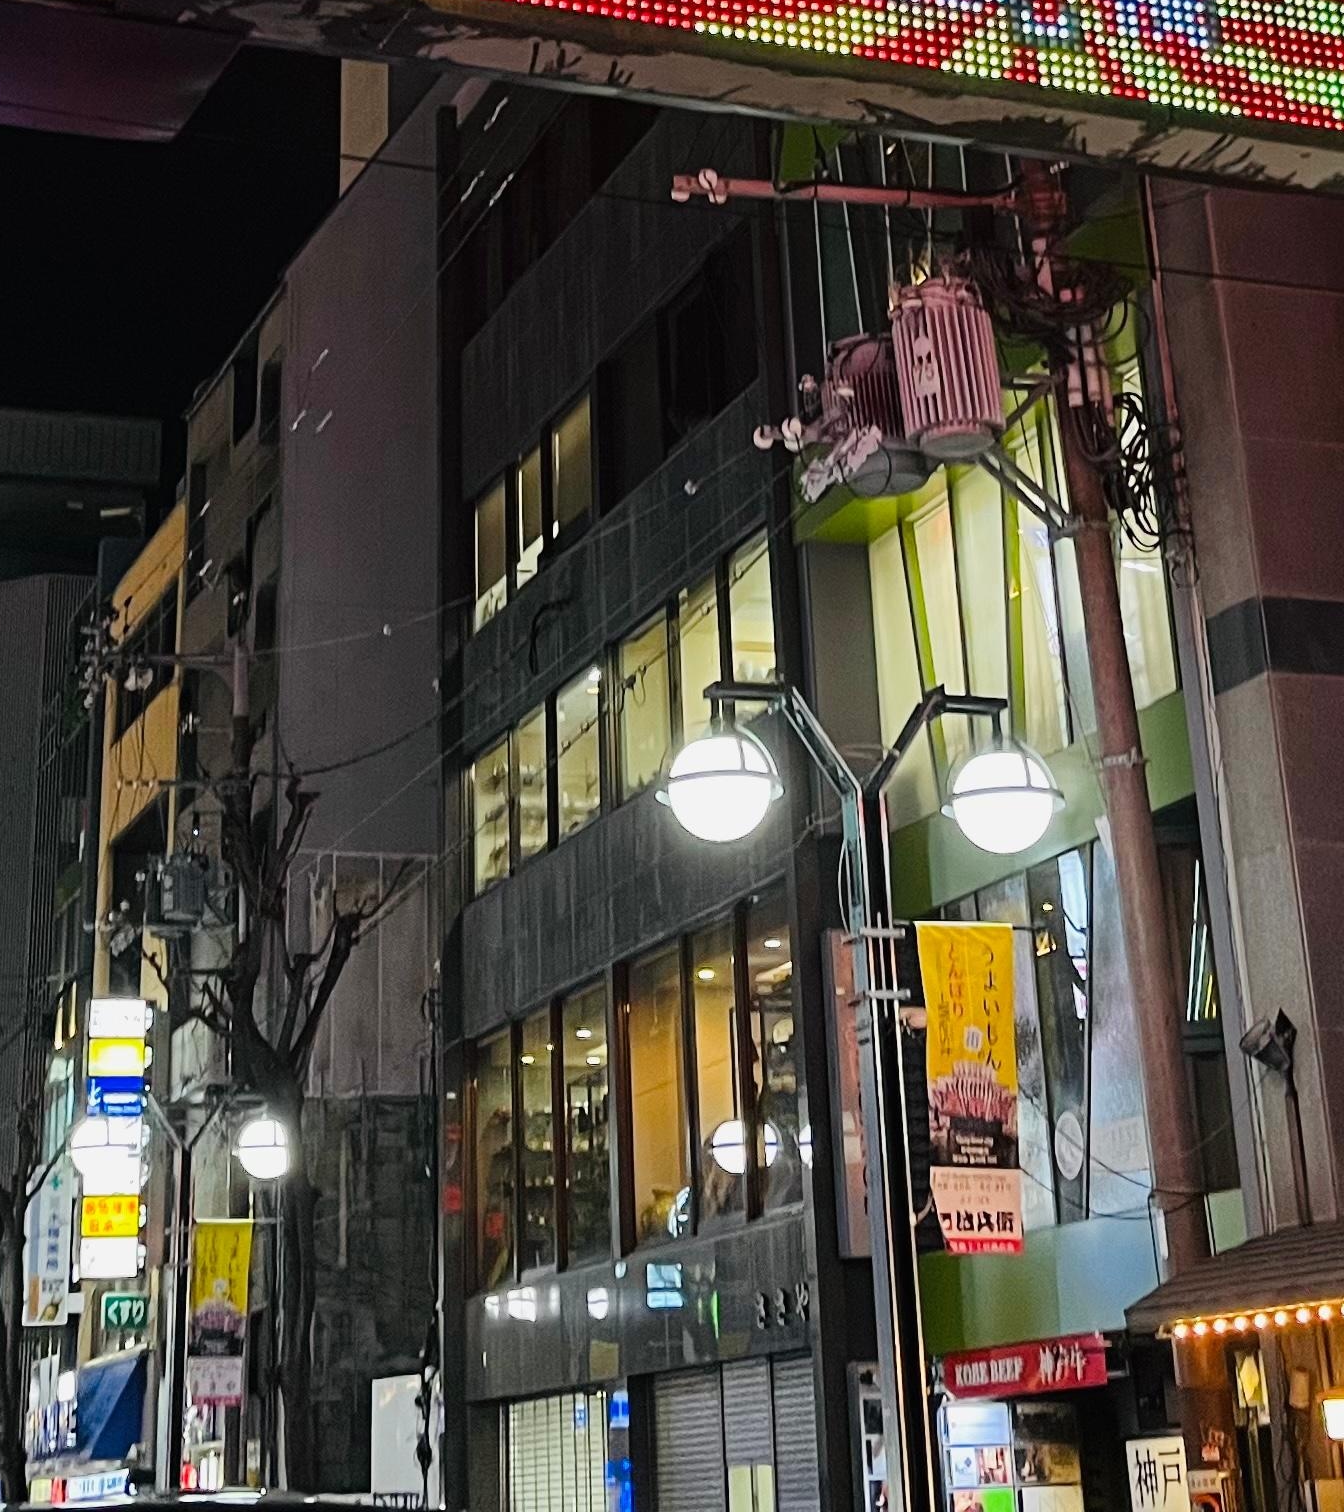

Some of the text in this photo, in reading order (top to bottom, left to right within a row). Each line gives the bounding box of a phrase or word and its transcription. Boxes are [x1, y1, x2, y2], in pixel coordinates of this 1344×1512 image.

[106, 1298, 146, 1327] くすり
[955, 1355, 1025, 1387] KOBE BEEF
